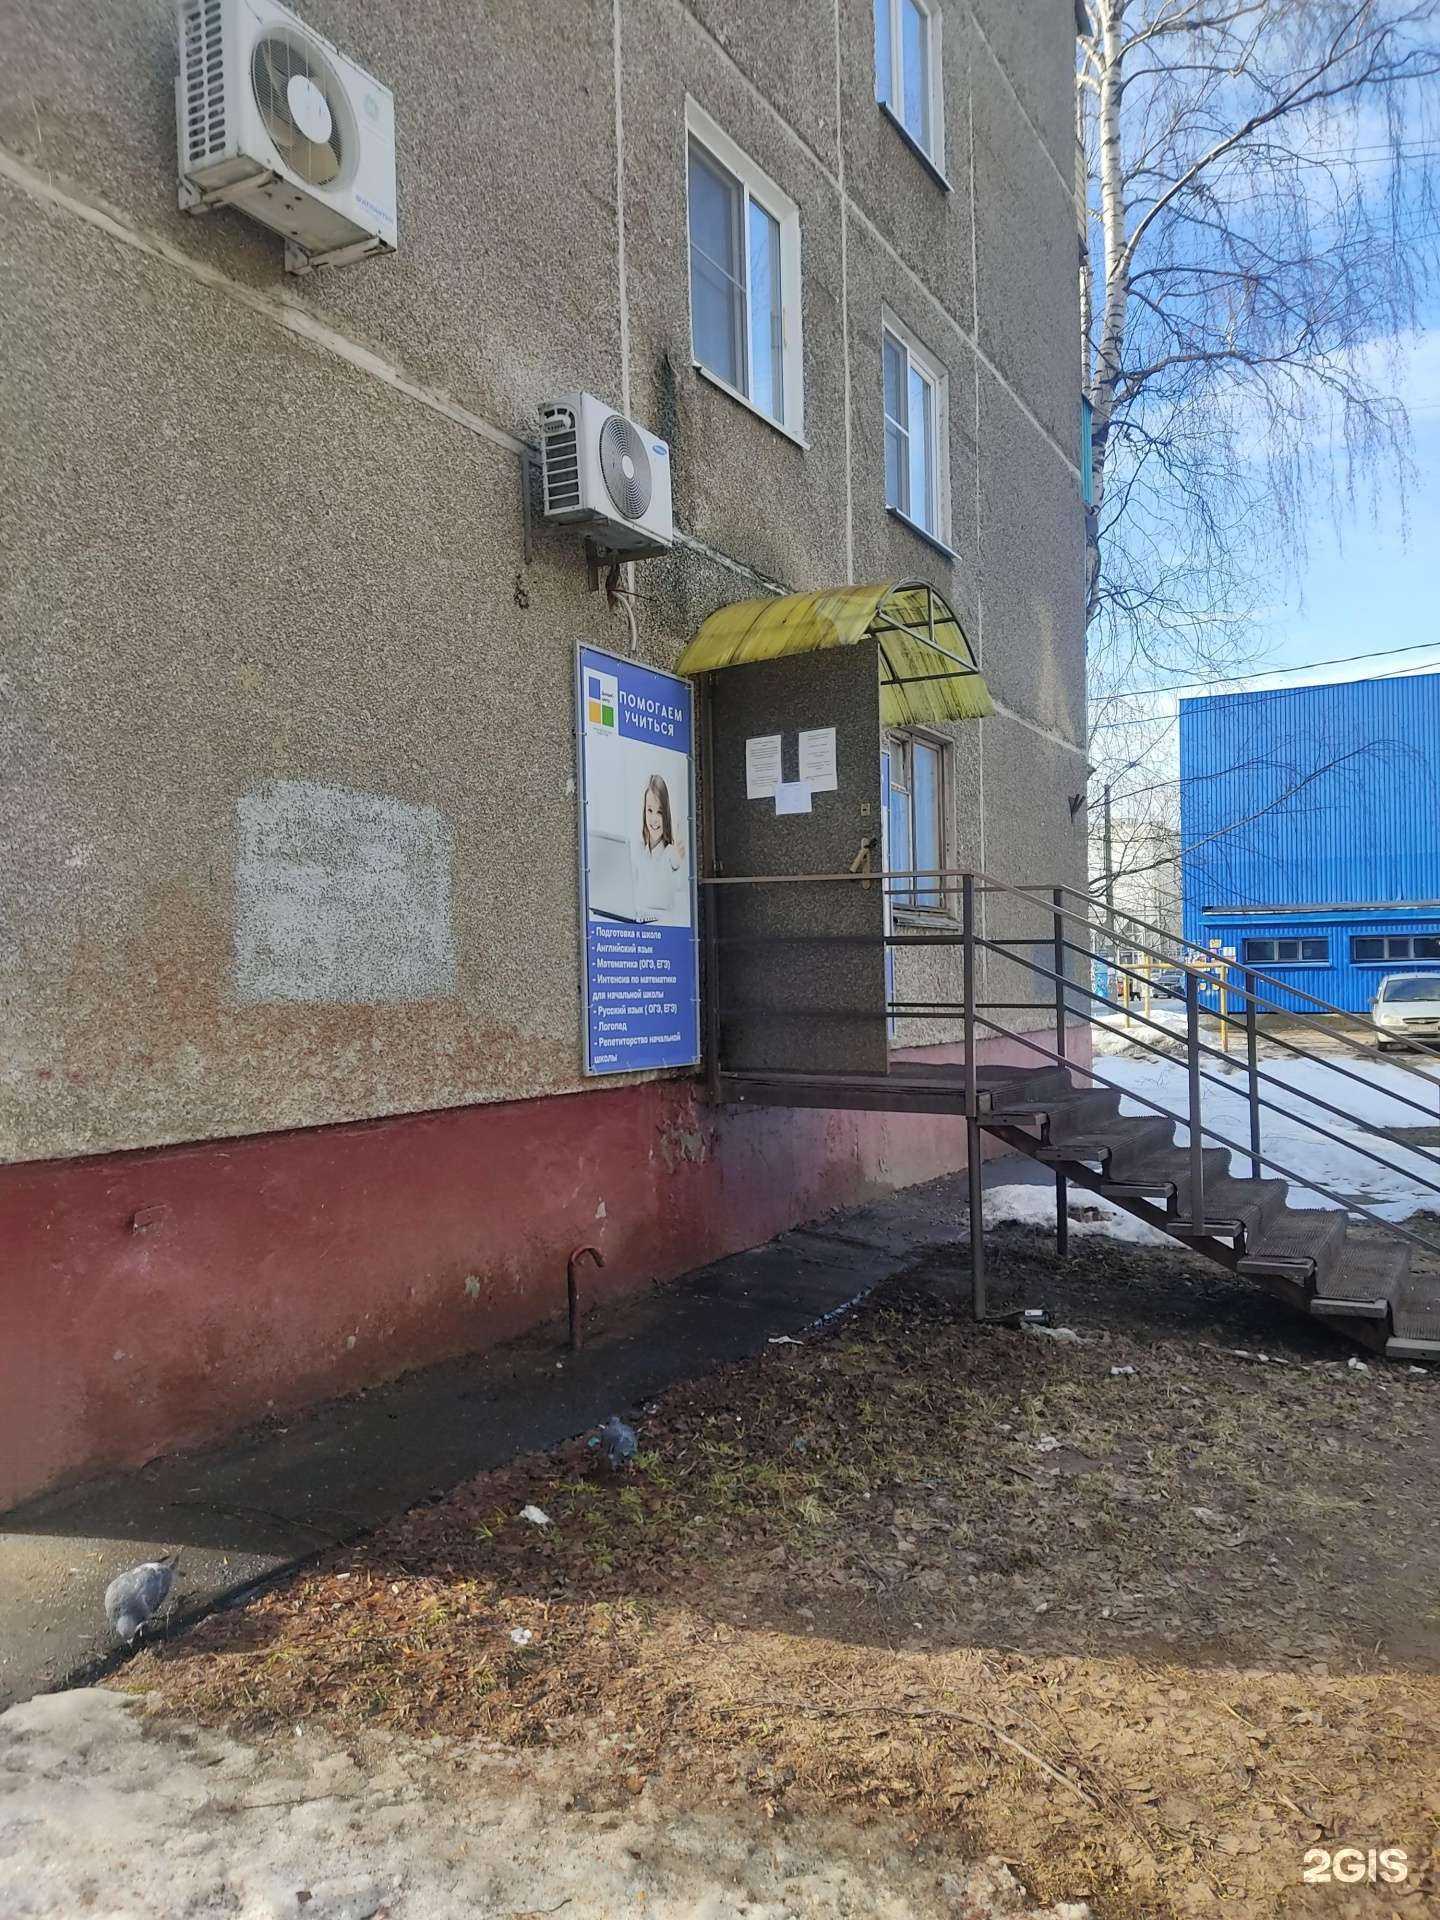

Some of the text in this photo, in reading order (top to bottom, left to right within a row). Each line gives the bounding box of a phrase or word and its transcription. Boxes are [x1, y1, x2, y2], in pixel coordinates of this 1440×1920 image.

[620, 691, 682, 721] ПОМОГАЕМ
[625, 711, 674, 736] УЧИТЬСЯ
[596, 927, 635, 939] Подготовка
[641, 931, 661, 939] школе
[596, 943, 636, 953] Английский
[597, 958, 671, 970] Математика (ОГЭ, ЕГЭ)
[597, 974, 630, 984] Интенсив
[640, 976, 677, 984] математике
[592, 989, 664, 1001] для начальной школы
[597, 1004, 626, 1017] Русский
[627, 1006, 644, 1014] язык
[663, 1003, 677, 1014] ЕГЭ)
[598, 1021, 627, 1032] Логопед
[598, 1032, 681, 1047] Репетиторство начальной
[594, 1054, 618, 1064] школы
